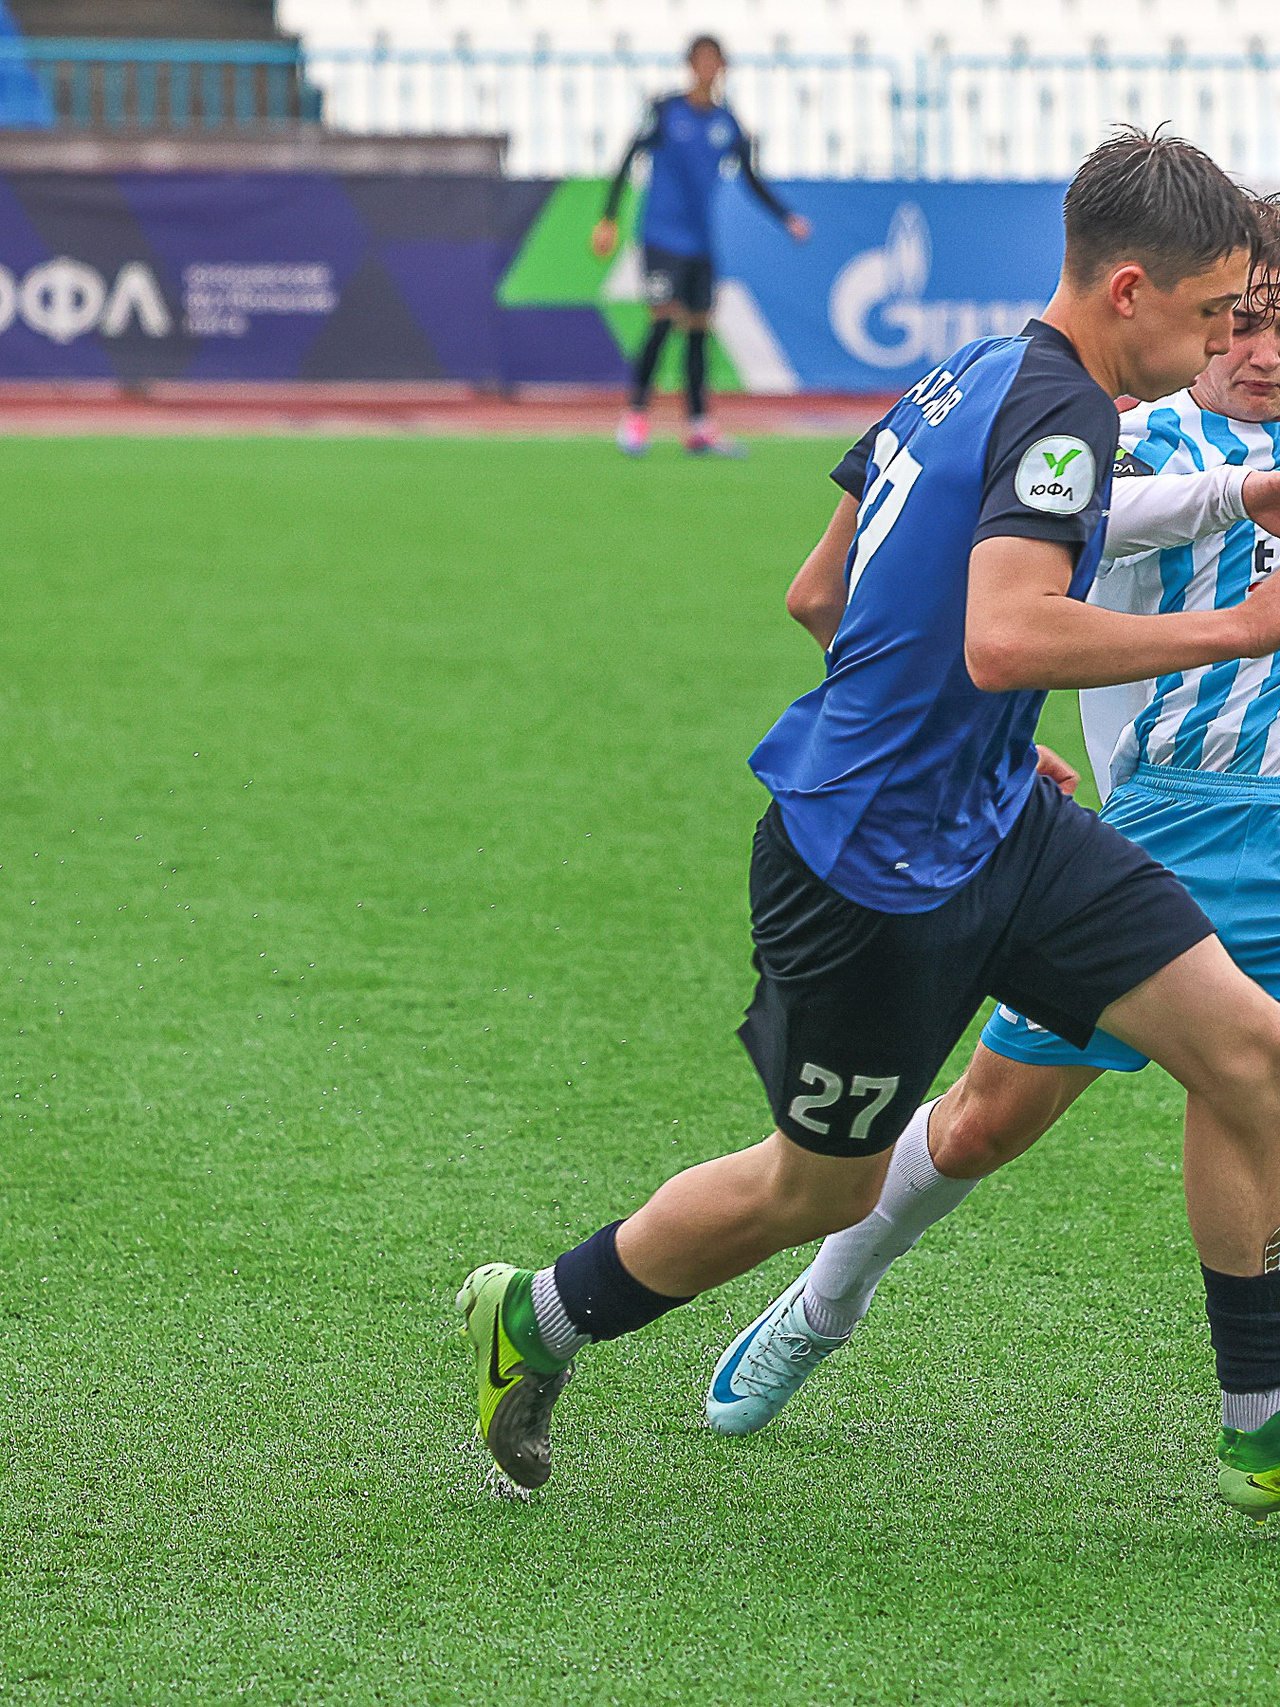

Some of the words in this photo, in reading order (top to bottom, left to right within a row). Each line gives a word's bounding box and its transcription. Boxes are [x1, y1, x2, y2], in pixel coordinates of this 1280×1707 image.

[0, 256, 172, 344] ФЛ
[1029, 482, 1074, 501] ЮФЛ
[788, 1062, 900, 1139] 27
